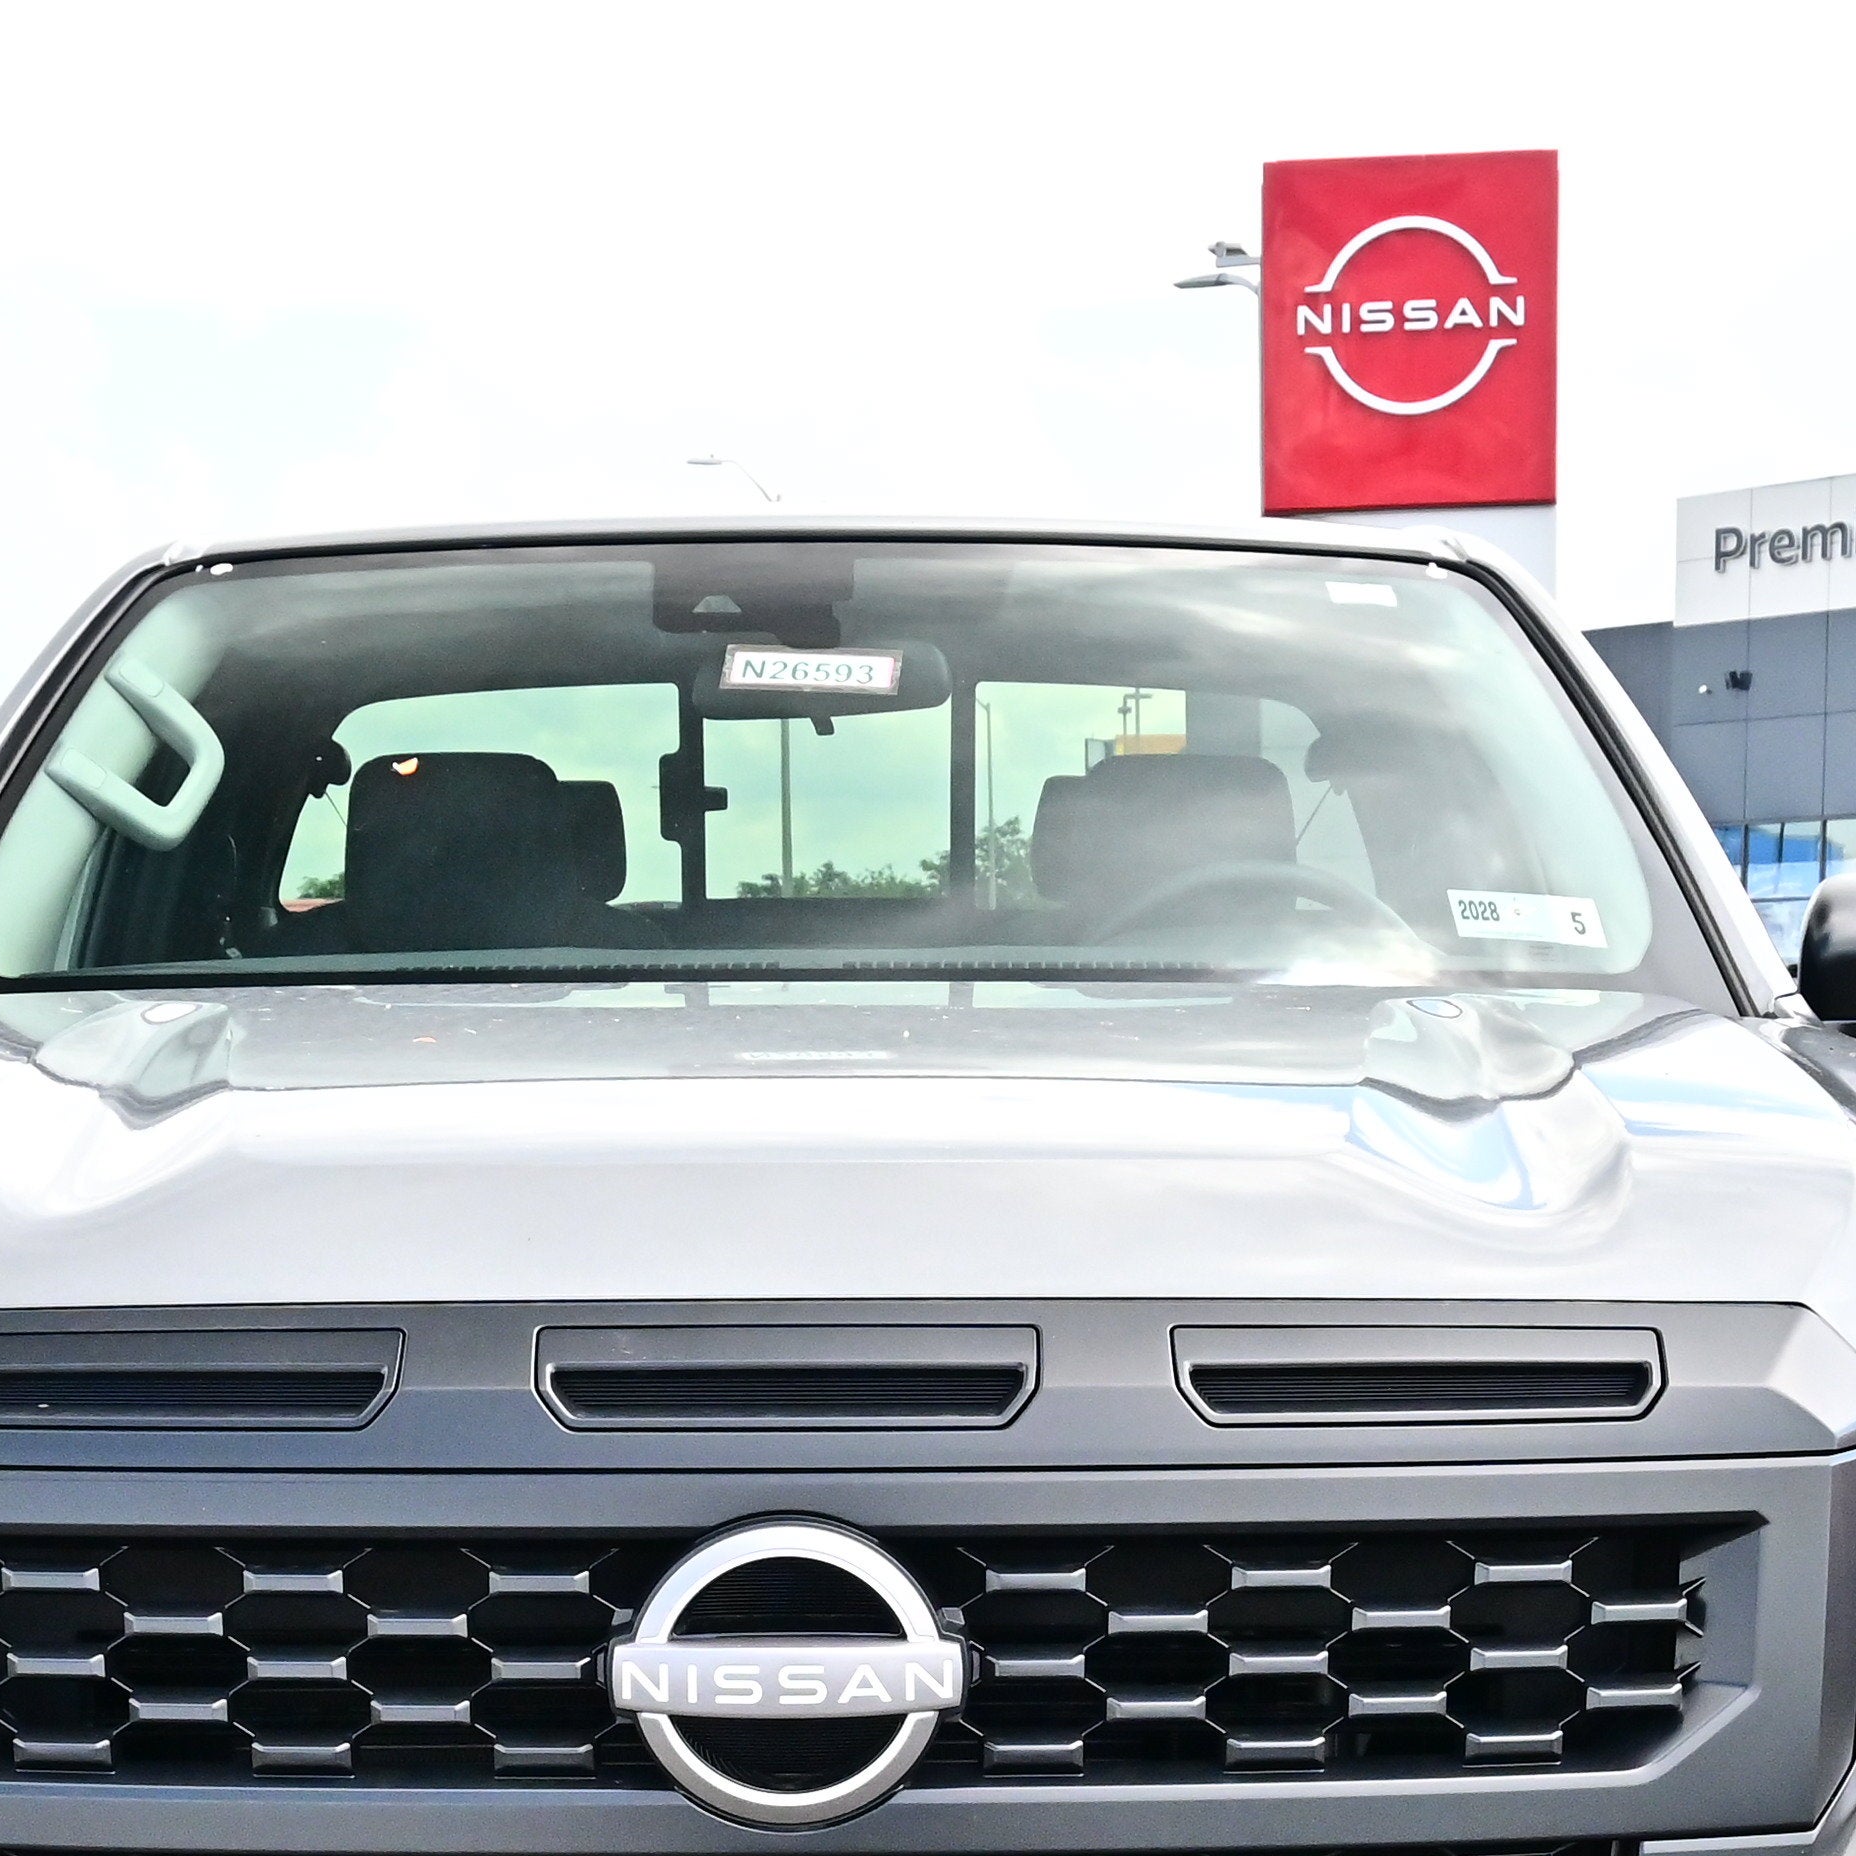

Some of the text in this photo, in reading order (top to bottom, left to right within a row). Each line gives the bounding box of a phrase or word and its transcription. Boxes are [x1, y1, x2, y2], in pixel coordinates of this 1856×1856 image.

[1296, 294, 1526, 336] NISSAN
[741, 659, 874, 684] N26593
[1458, 899, 1587, 935] 2028 5
[621, 1658, 954, 1706] NISSAN
